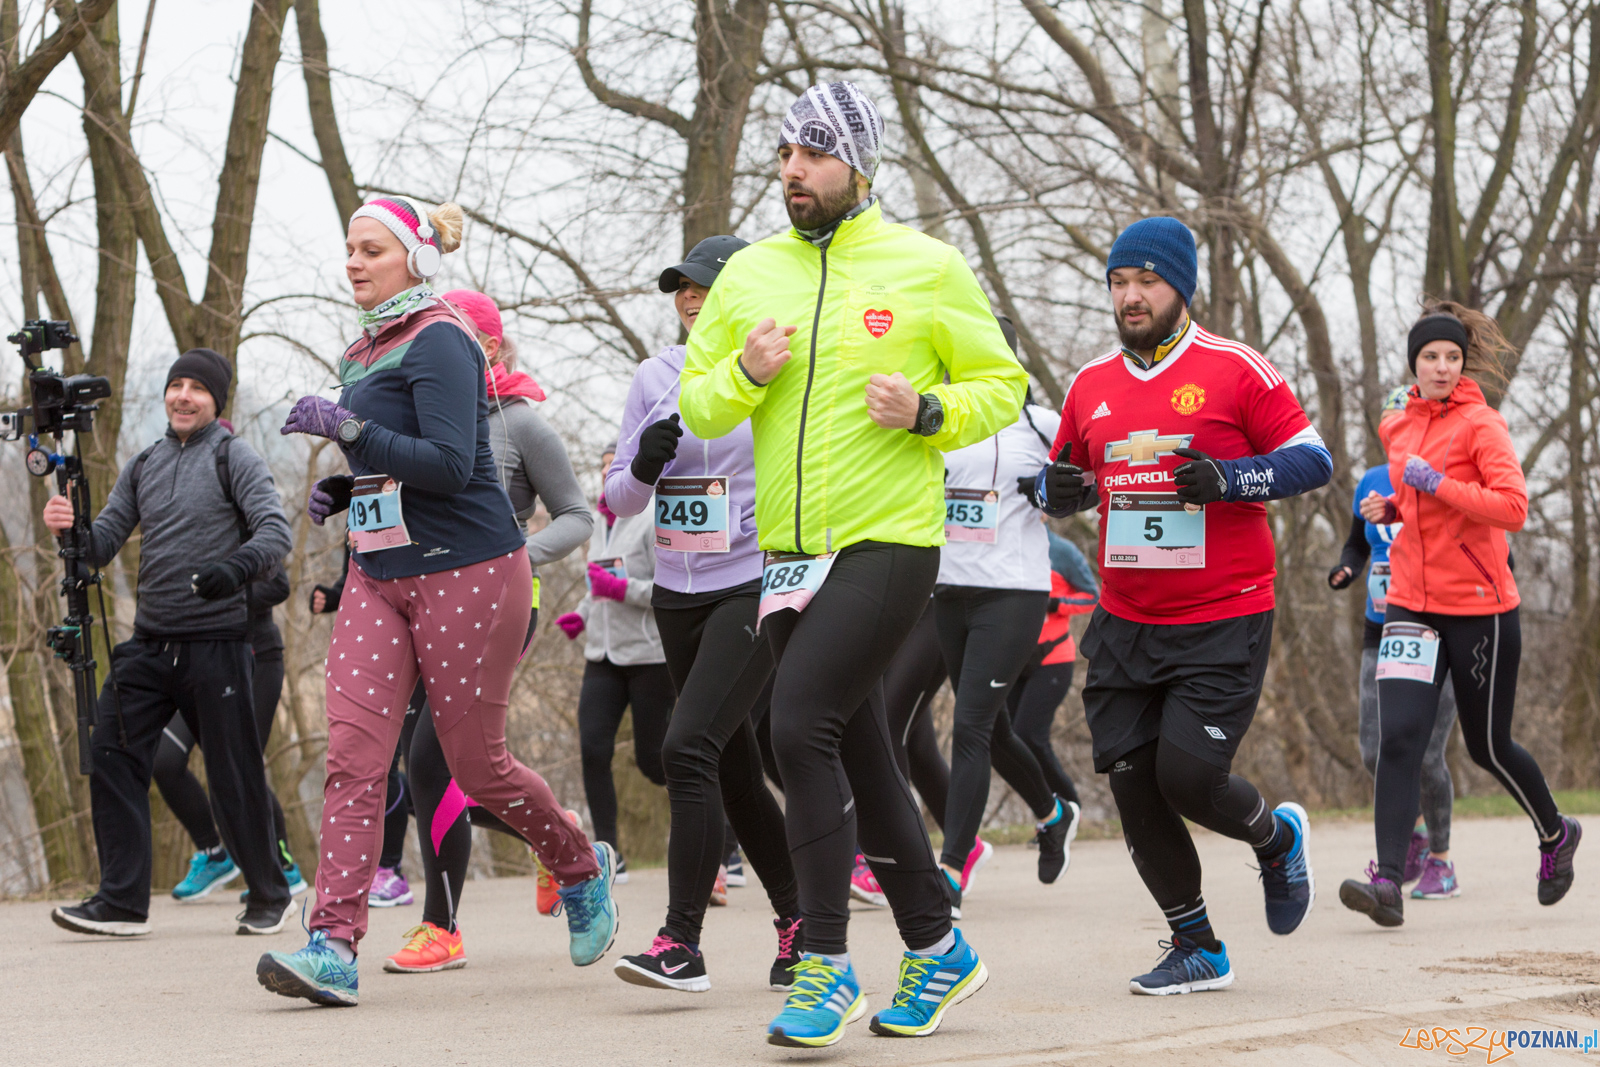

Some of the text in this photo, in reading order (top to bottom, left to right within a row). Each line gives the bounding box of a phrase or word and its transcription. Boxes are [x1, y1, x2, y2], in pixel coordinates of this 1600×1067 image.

[1104, 470, 1176, 487] CHEVROL
[1240, 482, 1271, 496] Bank
[351, 498, 382, 527] 191
[658, 499, 709, 526] 249
[946, 503, 984, 523] 453
[1143, 516, 1164, 542] 5
[763, 564, 809, 593] 488
[1379, 578, 1388, 595] 1
[1380, 640, 1421, 659] 493
